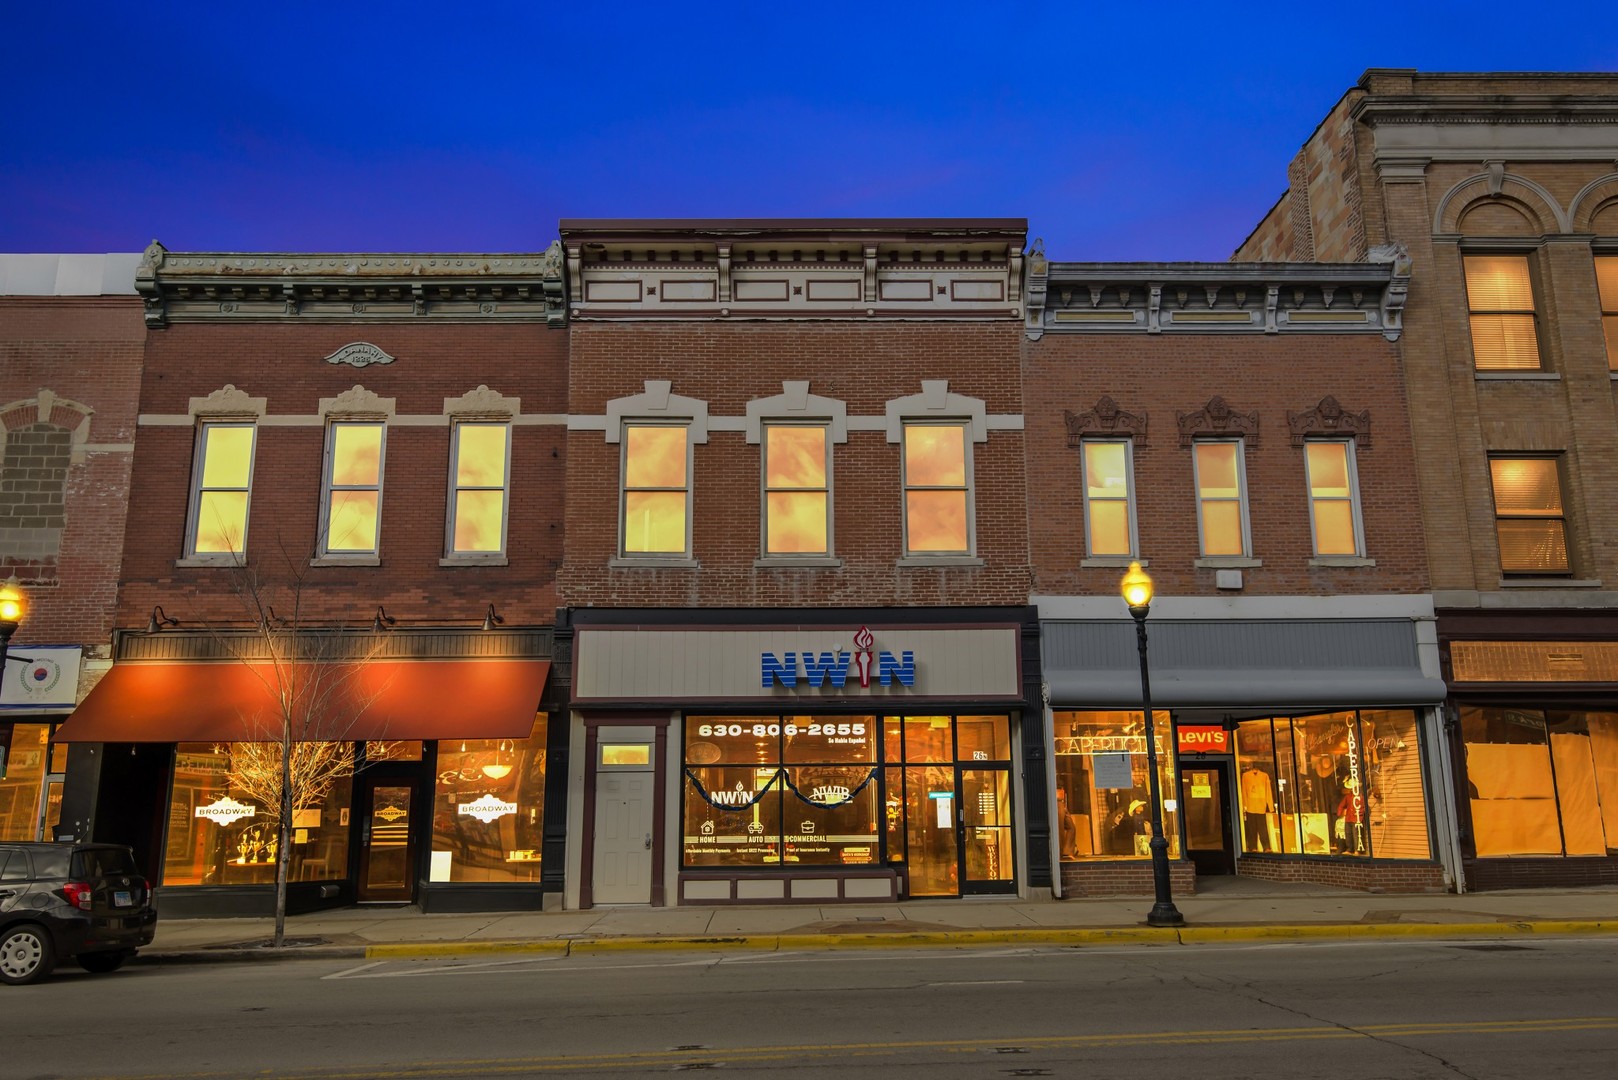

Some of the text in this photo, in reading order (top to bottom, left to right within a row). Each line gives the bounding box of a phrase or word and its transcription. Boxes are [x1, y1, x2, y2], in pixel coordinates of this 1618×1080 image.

[1345, 715, 1365, 851] CAPERUCITA
[462, 805, 514, 813] BROADWAY
[789, 835, 826, 843] COMMERCIAL
[986, 846, 999, 880] WELCO
